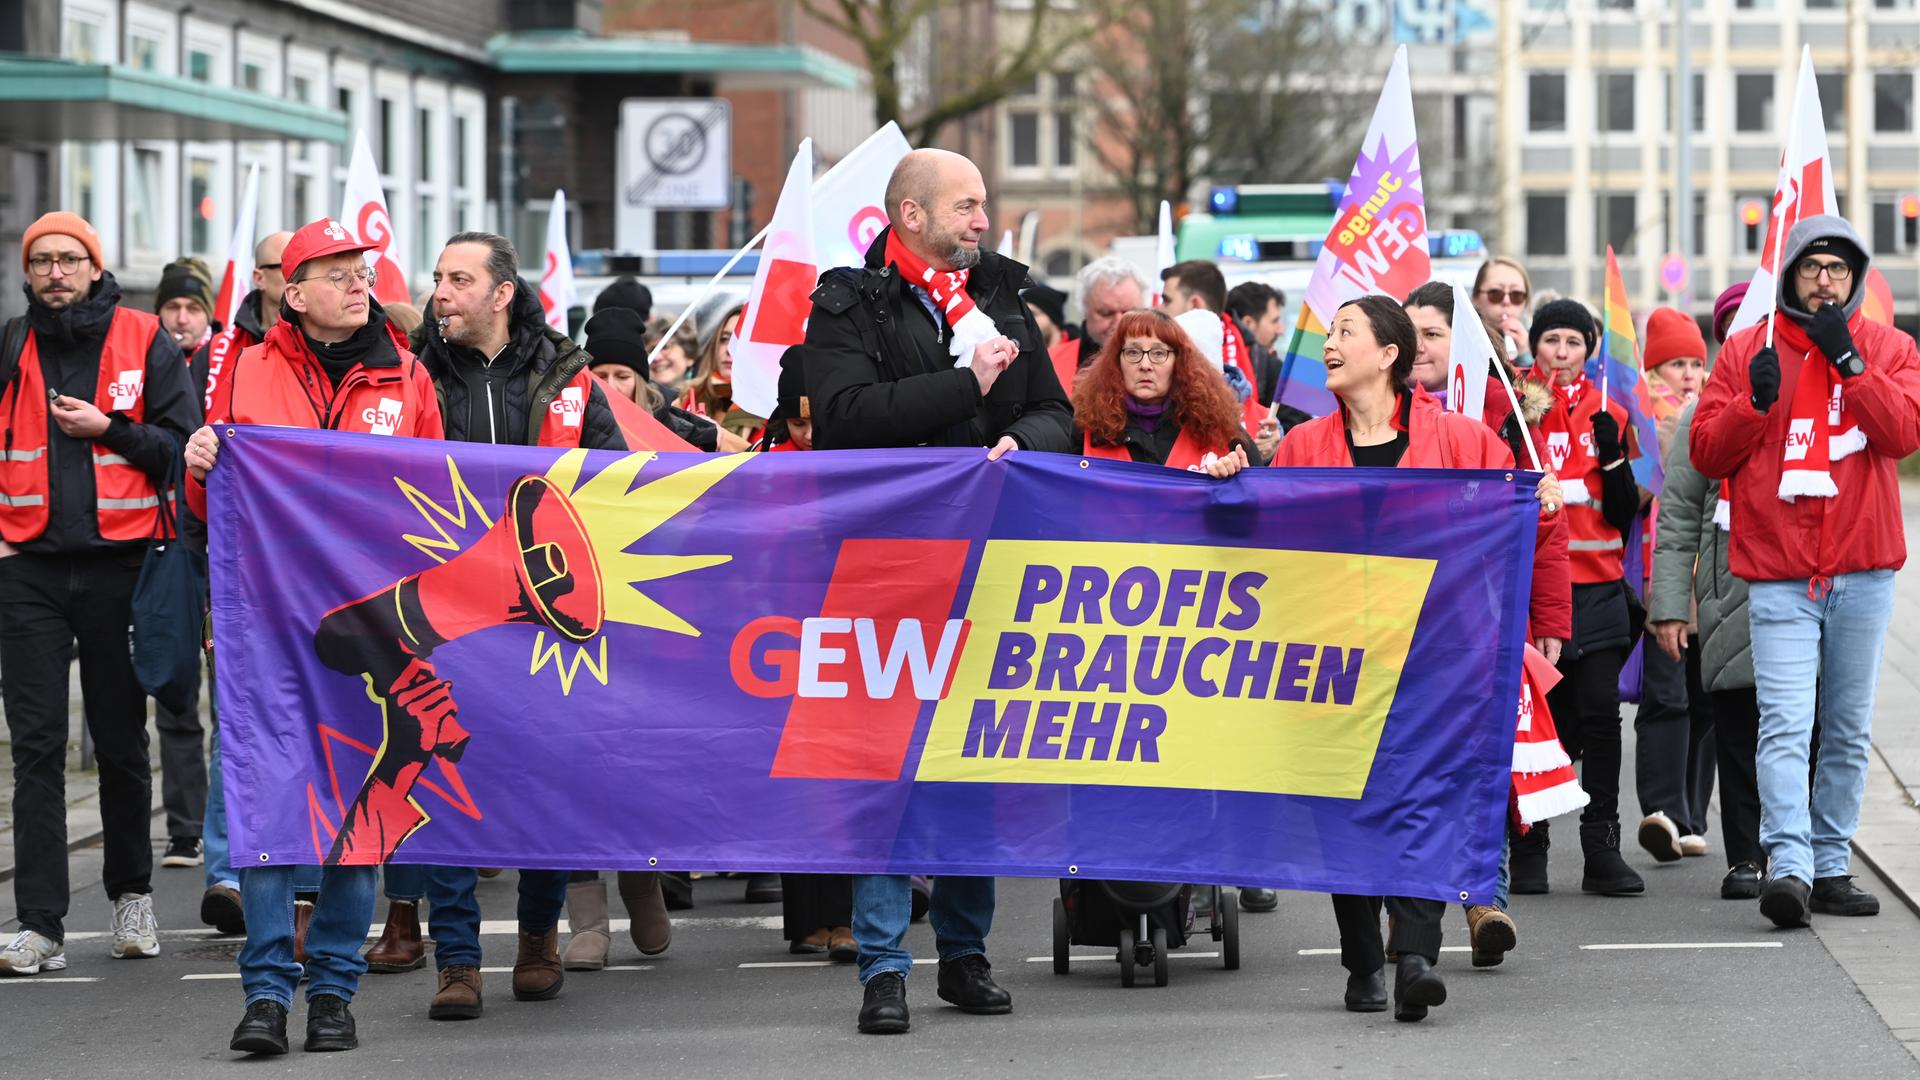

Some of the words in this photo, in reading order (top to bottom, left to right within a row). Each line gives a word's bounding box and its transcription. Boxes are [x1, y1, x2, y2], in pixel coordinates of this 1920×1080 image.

[108, 382, 144, 398] GEW
[549, 400, 585, 415] GEW
[361, 407, 404, 431] GEW
[1784, 431, 1815, 448] EW
[1014, 563, 1269, 632] PROFIS
[729, 615, 972, 700] GEW
[987, 631, 1365, 706] BRAUCHEN
[961, 699, 1169, 763] MEHR
